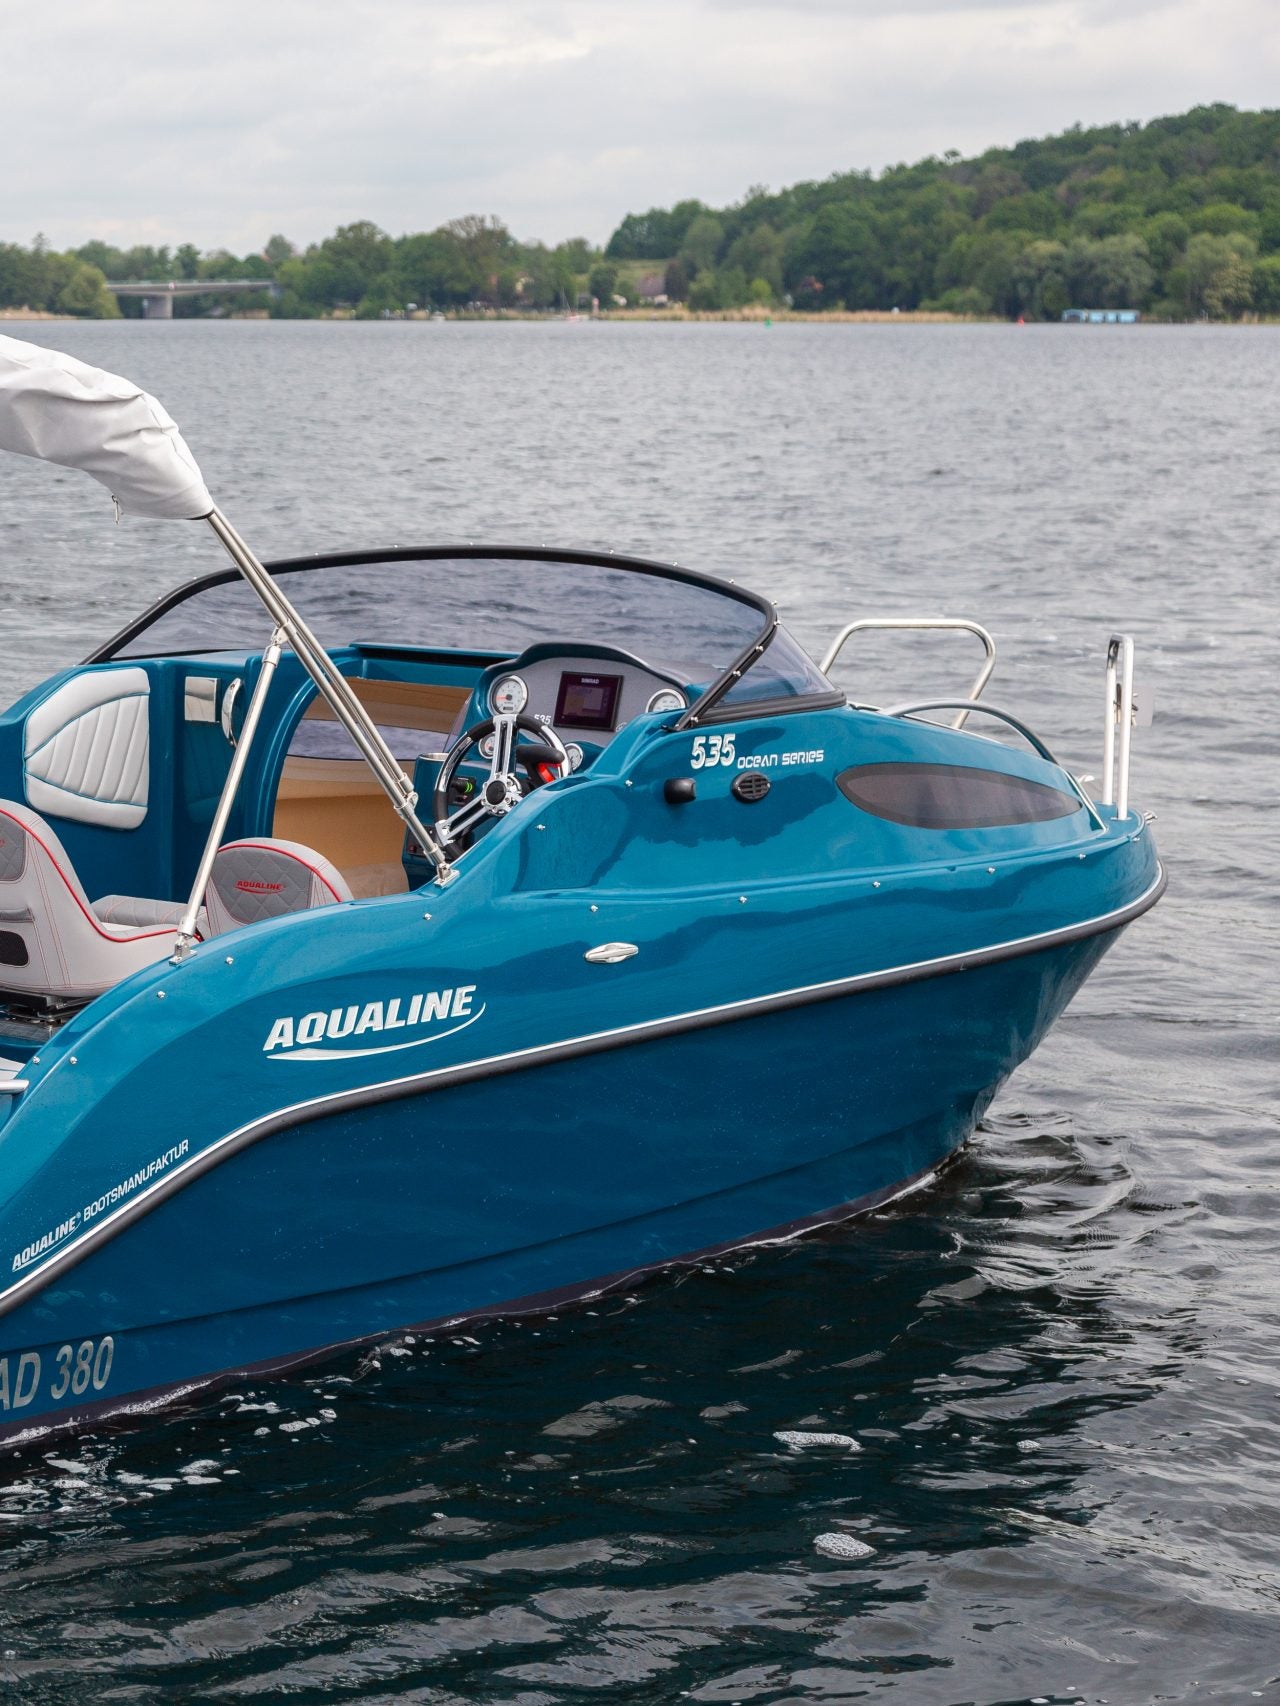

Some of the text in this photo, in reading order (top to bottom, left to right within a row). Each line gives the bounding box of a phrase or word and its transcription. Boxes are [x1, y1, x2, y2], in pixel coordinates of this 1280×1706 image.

[690, 733, 736, 769] 535
[262, 984, 477, 1051] AQUALINE
[83, 1139, 189, 1222] BOOTSMANUFAKTUR
[51, 1335, 114, 1400] 380
